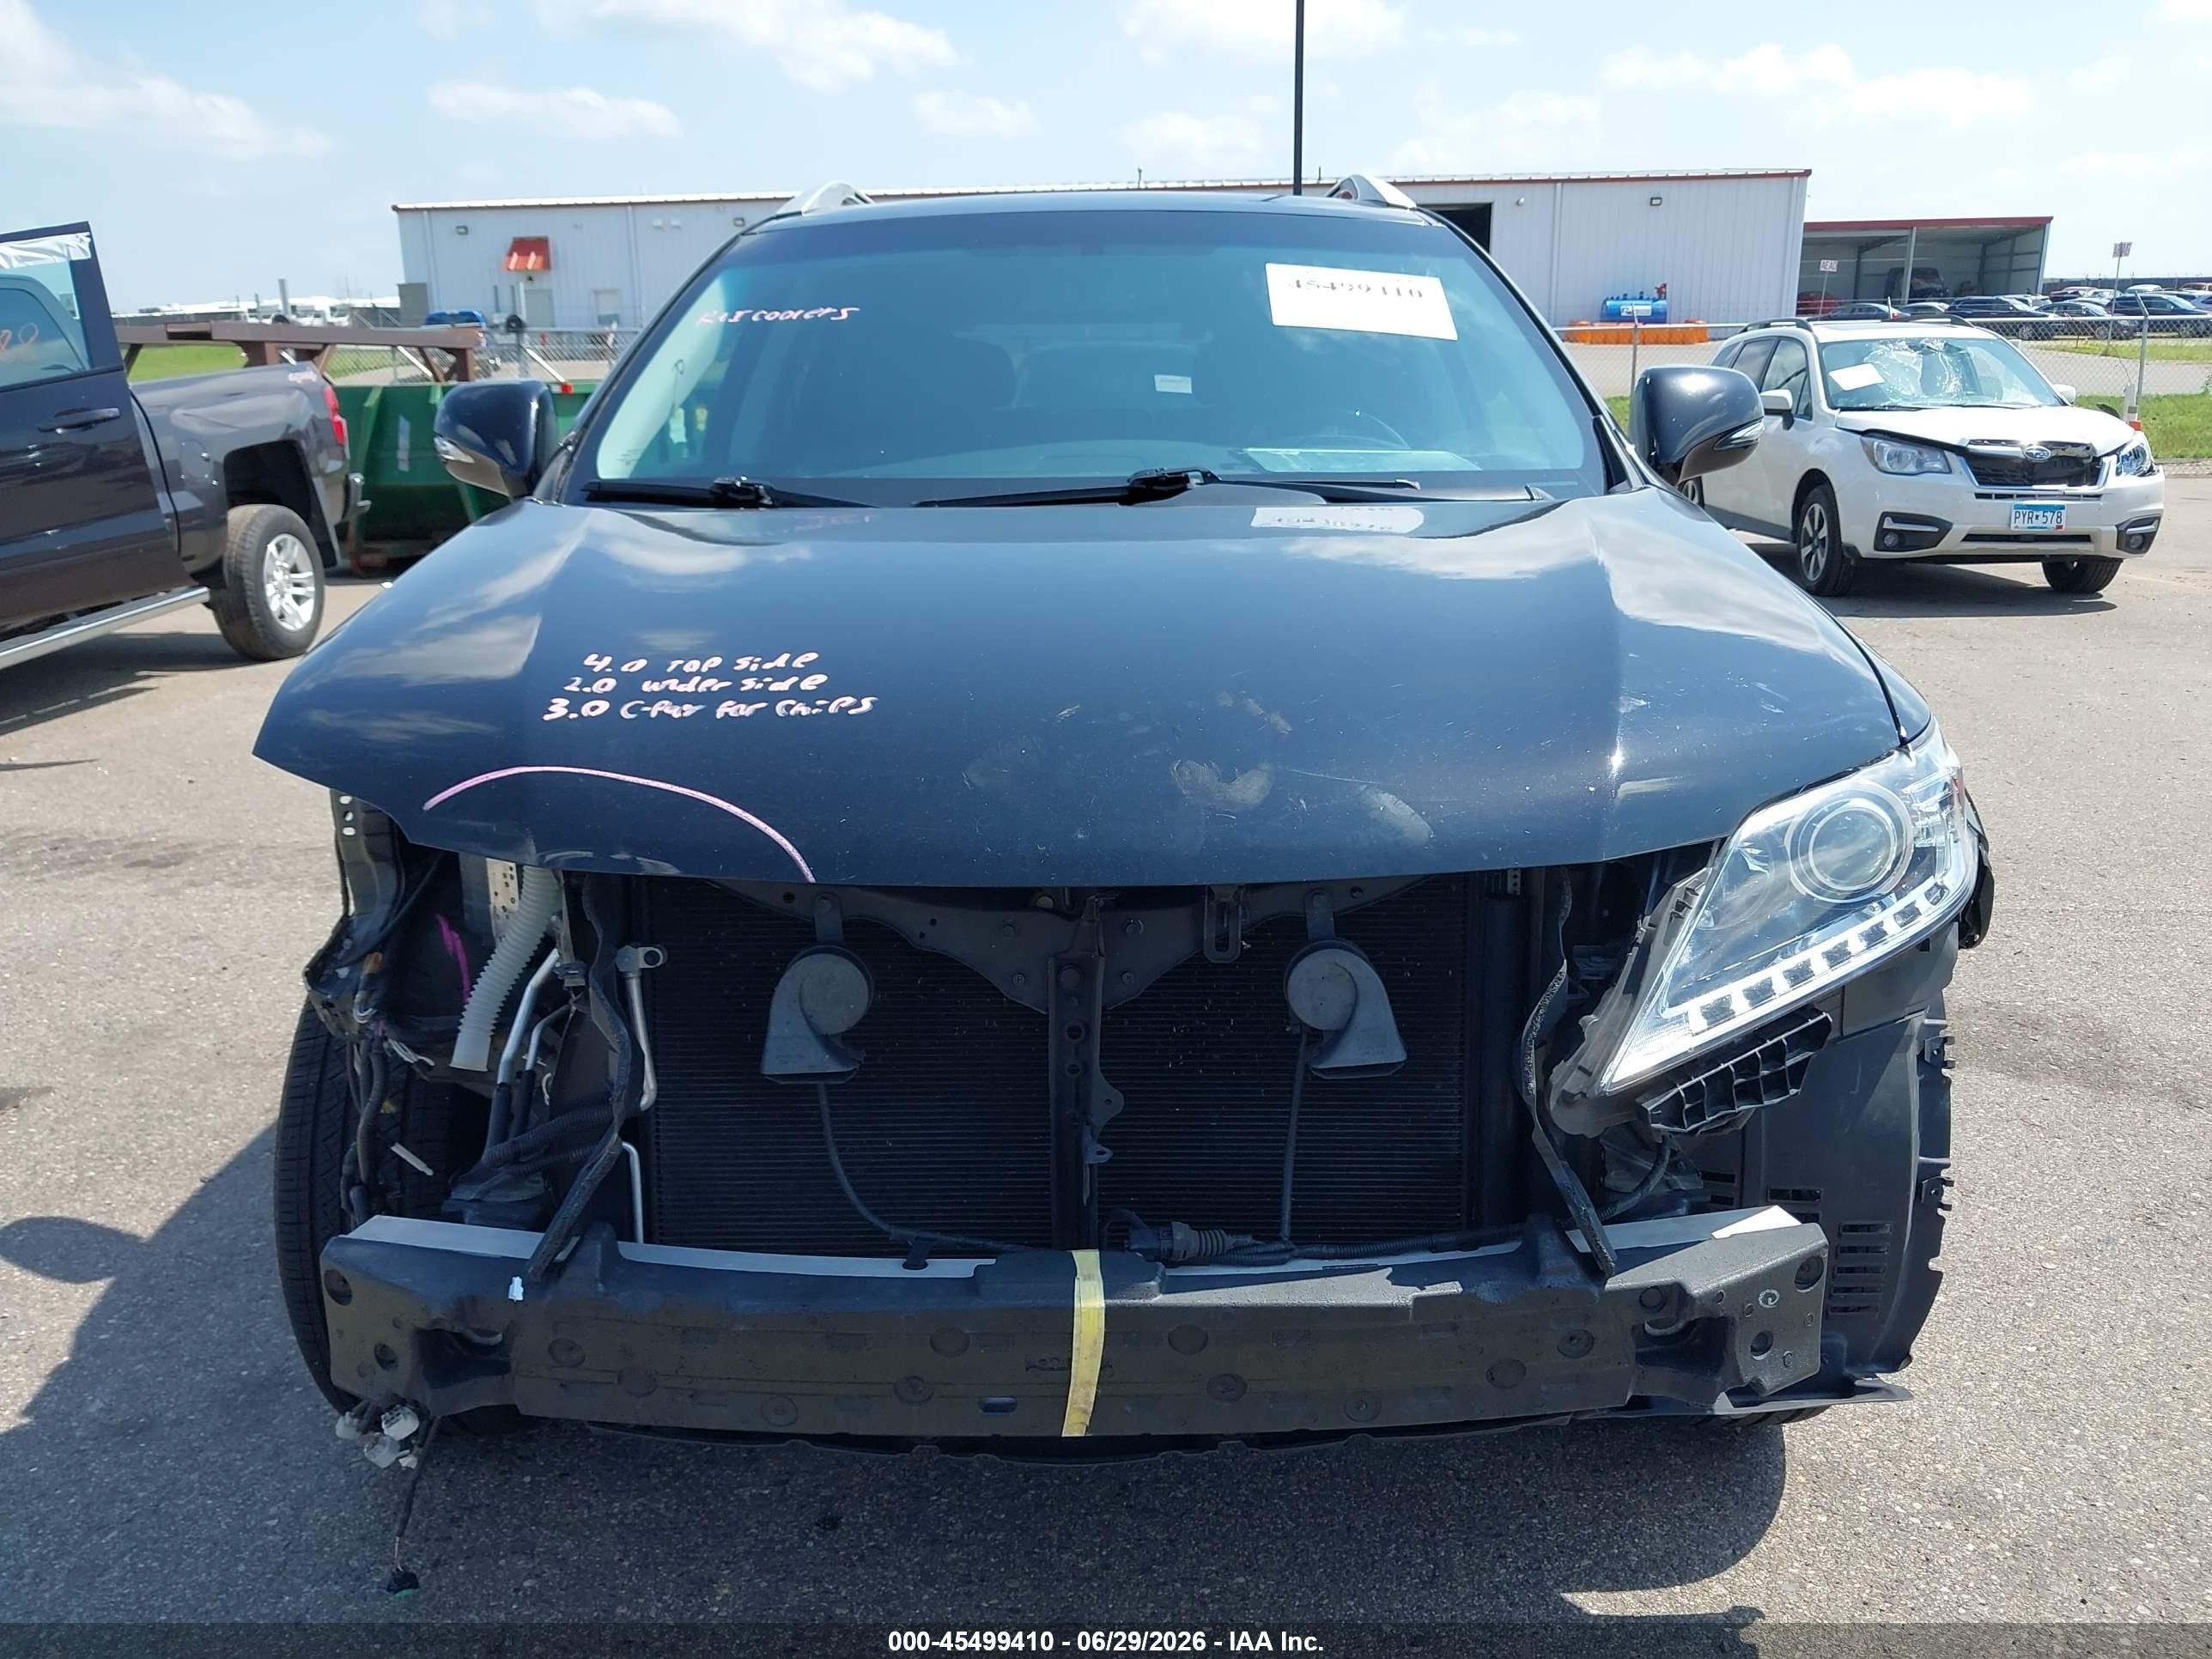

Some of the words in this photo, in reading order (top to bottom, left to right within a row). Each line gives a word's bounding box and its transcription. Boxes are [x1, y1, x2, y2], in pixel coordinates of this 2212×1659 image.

[2014, 510, 2033, 524] PYR
[2042, 510, 2063, 524] 578
[583, 653, 648, 673] 4.0
[563, 675, 617, 694] 2.0
[543, 696, 611, 721] 3.0
